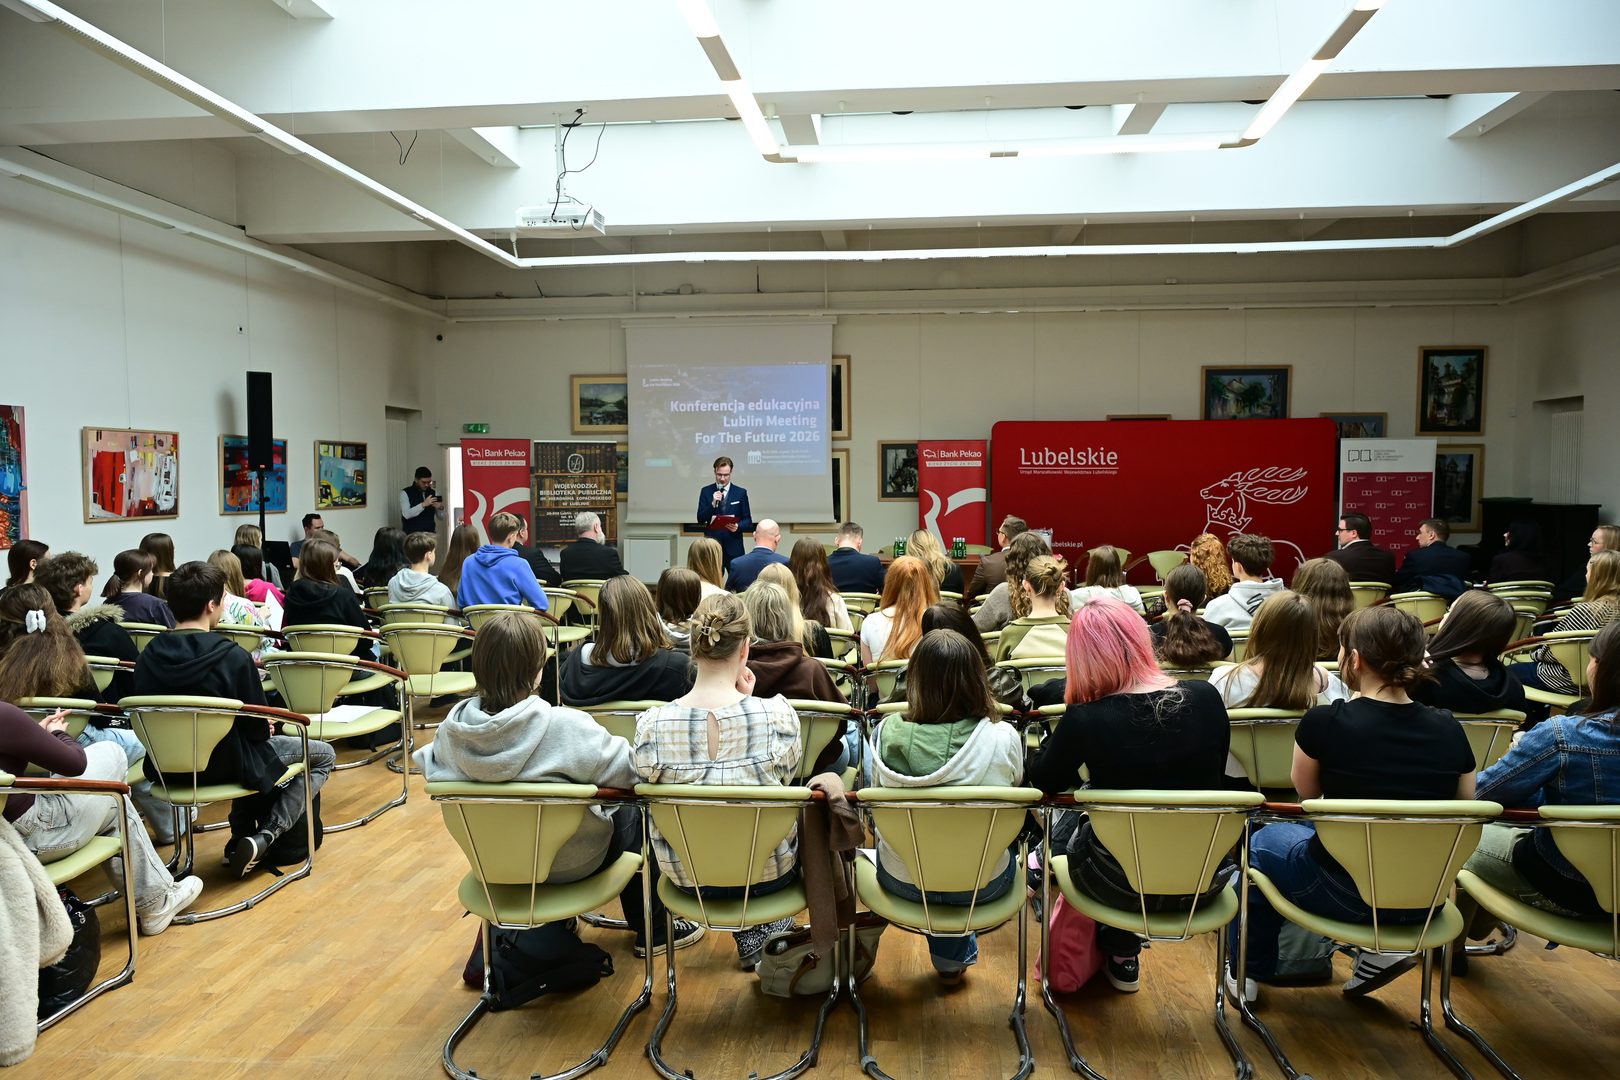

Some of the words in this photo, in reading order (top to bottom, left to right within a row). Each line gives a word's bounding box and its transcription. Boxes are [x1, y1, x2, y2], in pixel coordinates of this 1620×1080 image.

[670, 400, 745, 413] Konferencja
[748, 399, 820, 412] edukacyjna
[723, 415, 762, 427] Lublin
[766, 415, 817, 428] Meeting
[695, 432, 716, 444] For
[718, 431, 741, 443] The
[744, 431, 786, 443] Future
[789, 431, 820, 442] 2026
[484, 449, 503, 457] Bank
[504, 449, 526, 457] Pekao
[940, 450, 959, 458] Bank
[960, 450, 982, 458] Pekao
[1020, 447, 1118, 466] Lubelskie
